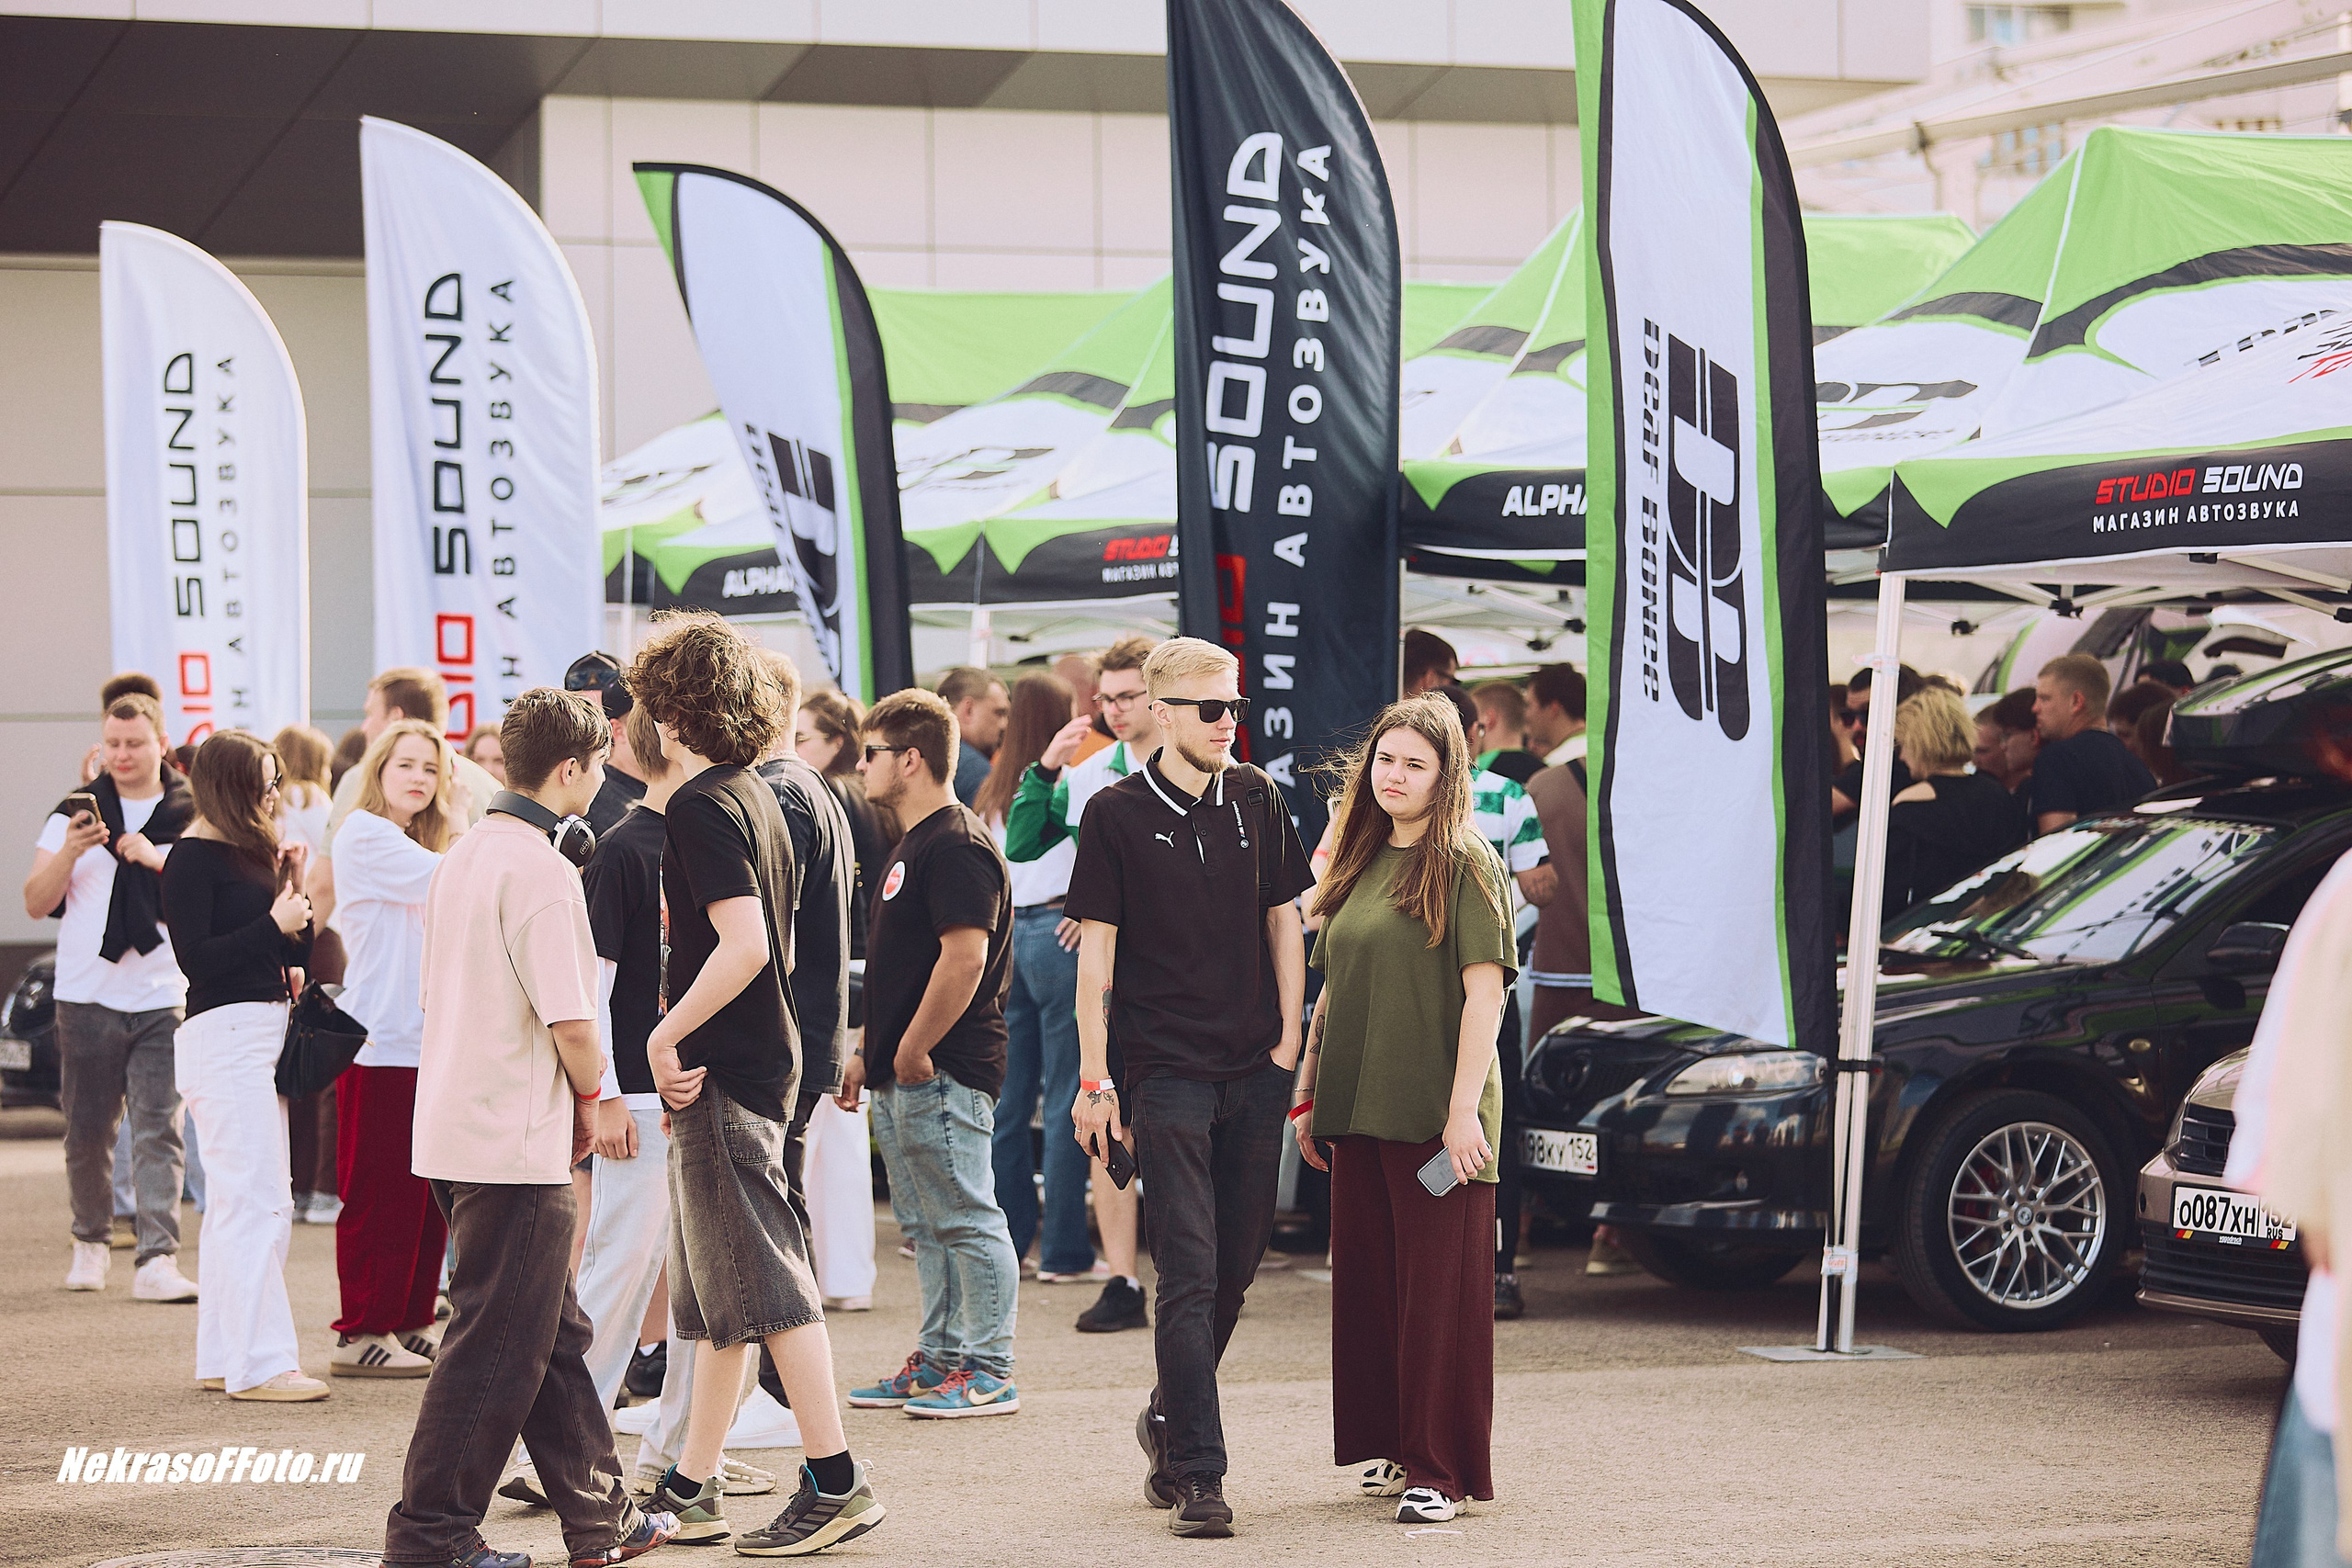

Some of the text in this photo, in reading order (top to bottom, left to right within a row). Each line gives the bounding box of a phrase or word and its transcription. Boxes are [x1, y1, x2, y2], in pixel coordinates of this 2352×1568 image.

[424, 273, 471, 576] SOUND
[488, 279, 519, 620] АВТОЗВУКА
[1205, 131, 1284, 513] SOUND
[1272, 144, 1332, 568] АВТОЗВУКА
[165, 352, 205, 617] SOUND
[217, 357, 246, 654] АВТОЗВУКА
[2092, 500, 2300, 534] МАГАЗИН АВТОЗВУКА
[2094, 463, 2303, 505] STUDIO SOUND
[2266, 1226, 2284, 1240] RUS
